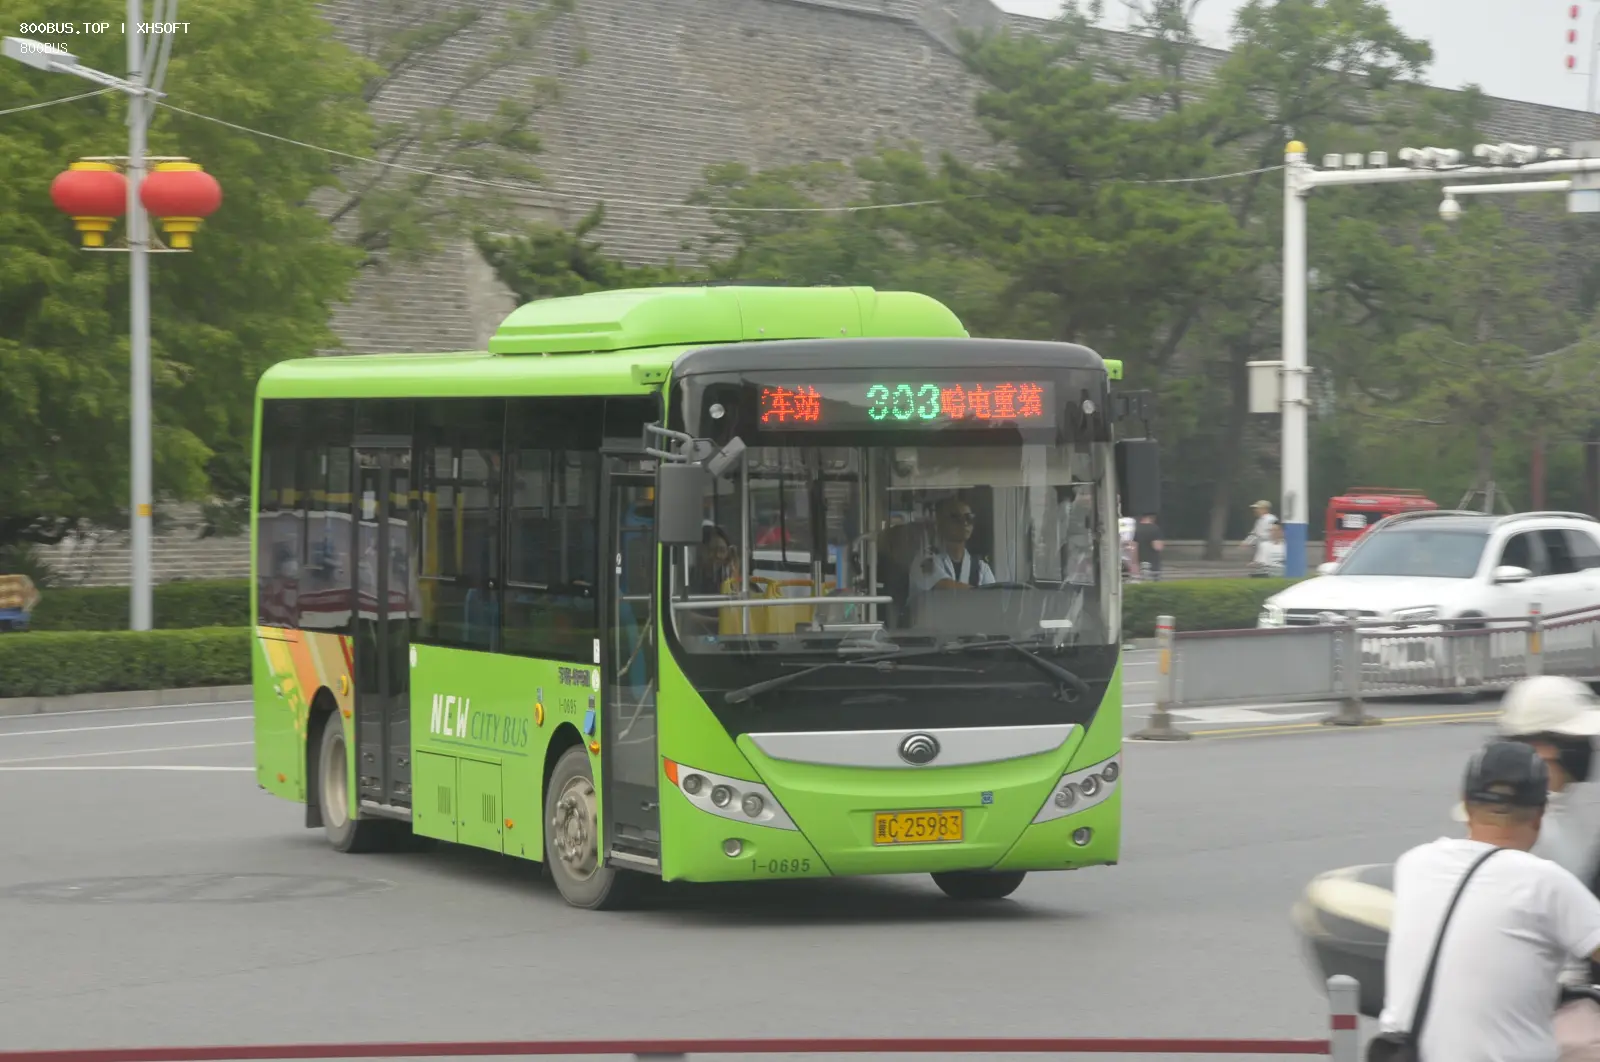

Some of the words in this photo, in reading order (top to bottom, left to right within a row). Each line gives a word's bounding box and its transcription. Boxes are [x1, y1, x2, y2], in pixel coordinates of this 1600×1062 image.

[761, 385, 821, 422] 车站
[866, 384, 941, 420] 303
[940, 382, 1043, 419] 哈电重装
[430, 693, 470, 738] NEW
[471, 711, 501, 743] CITY
[503, 716, 529, 748] BUS
[752, 858, 811, 874] 1-0695
